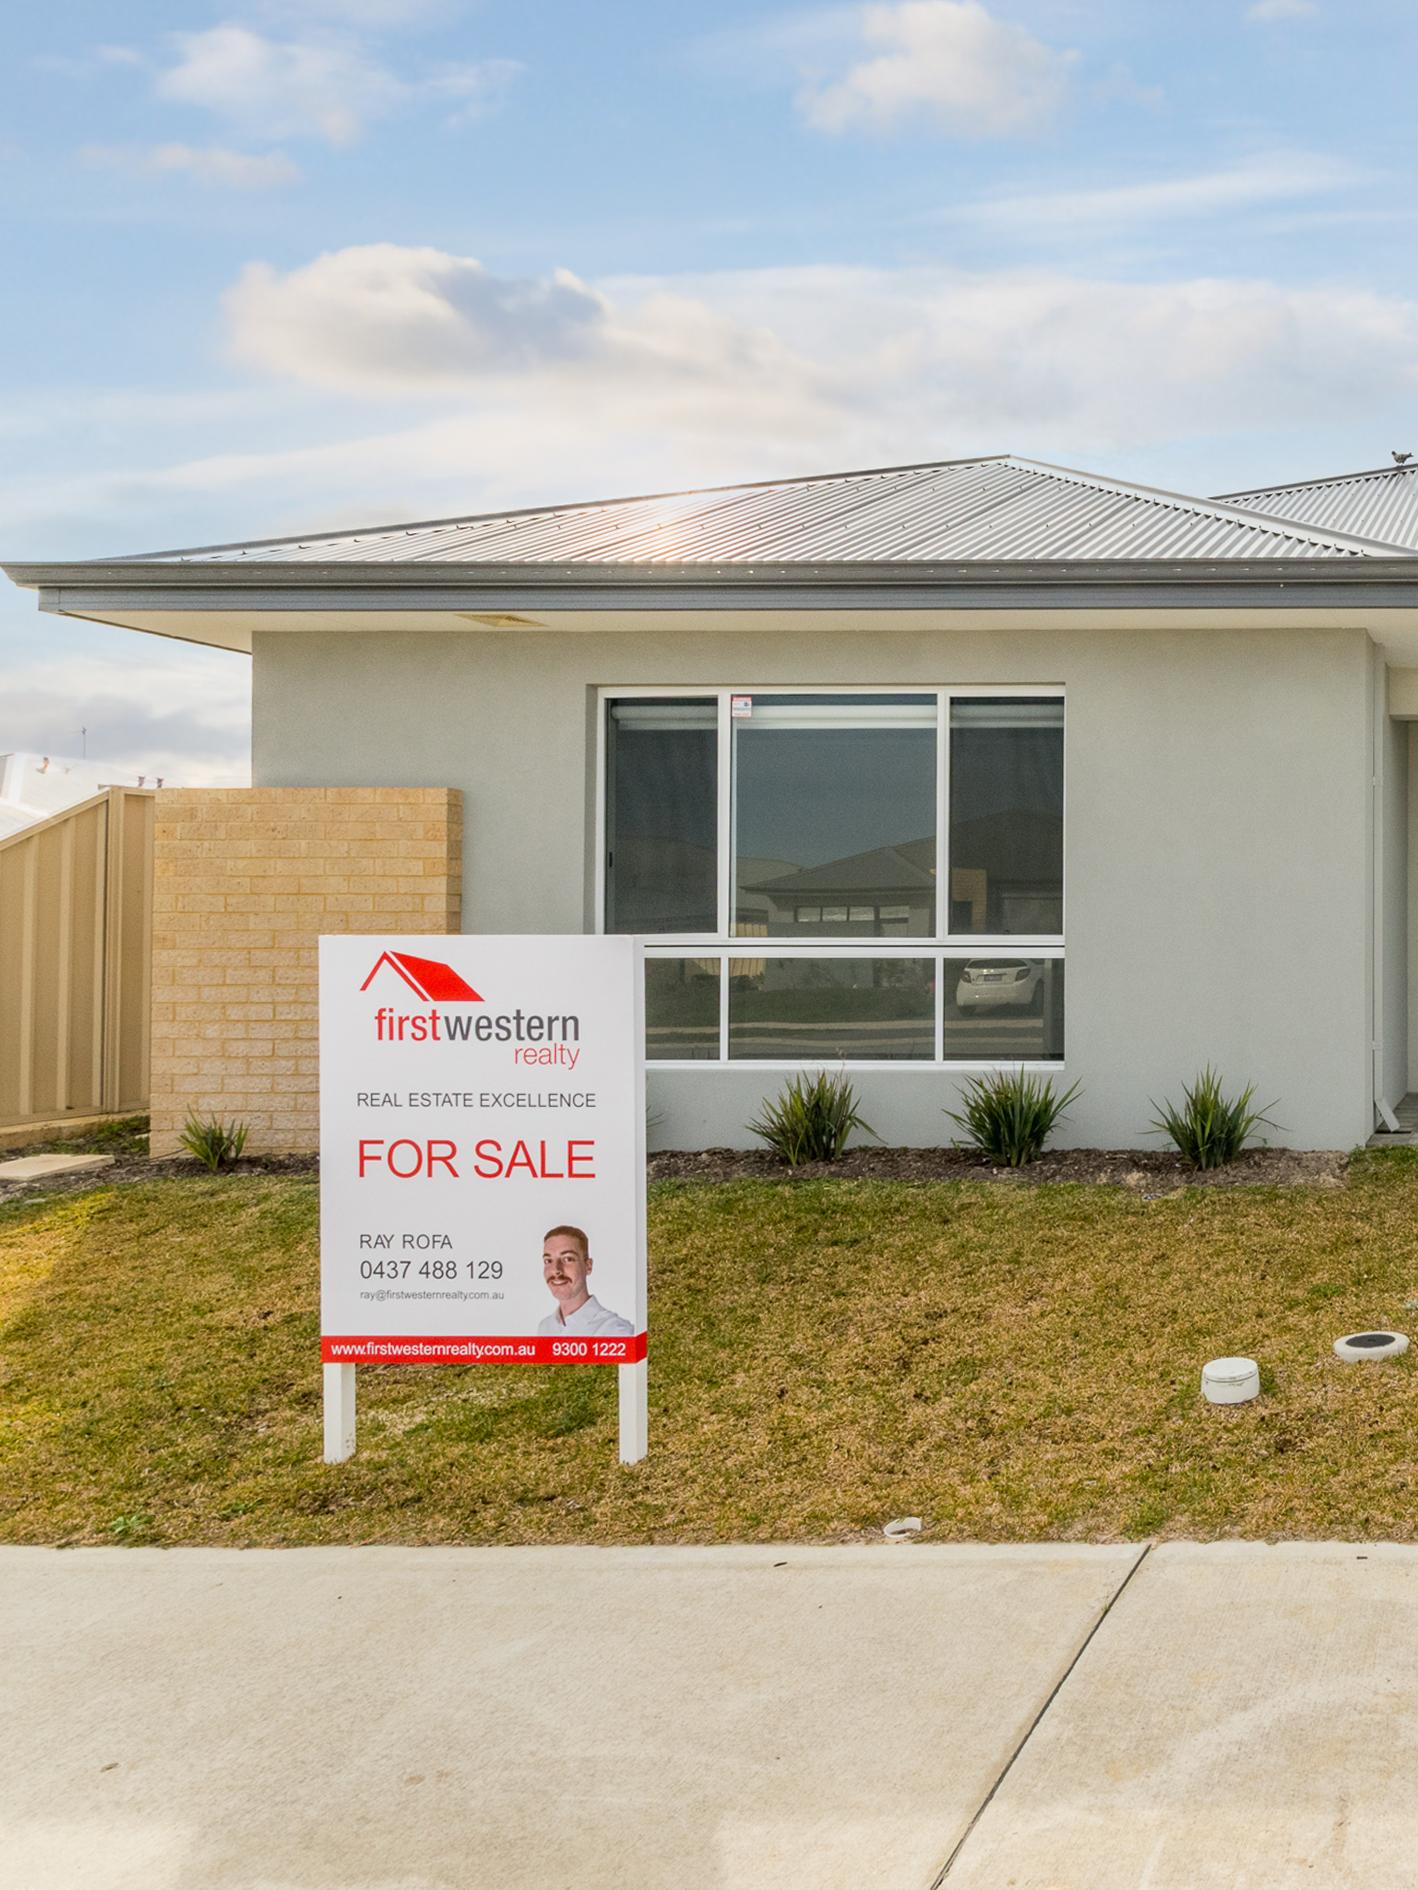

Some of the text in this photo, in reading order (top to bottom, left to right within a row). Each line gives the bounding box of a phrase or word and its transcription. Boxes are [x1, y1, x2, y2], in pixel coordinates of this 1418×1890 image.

[514, 1042, 580, 1070] realty
[357, 1093, 596, 1108] REAL ESTATE EXCELLENCE
[358, 1139, 596, 1179] FOR SALE
[359, 1234, 453, 1250] RAY ROFA
[360, 1260, 503, 1280] 0437 488 129
[360, 1289, 504, 1302] ray@firstwesternrealty.com.au
[331, 1342, 626, 1358] www.firstwesternrealty.com.au 9300 1222
